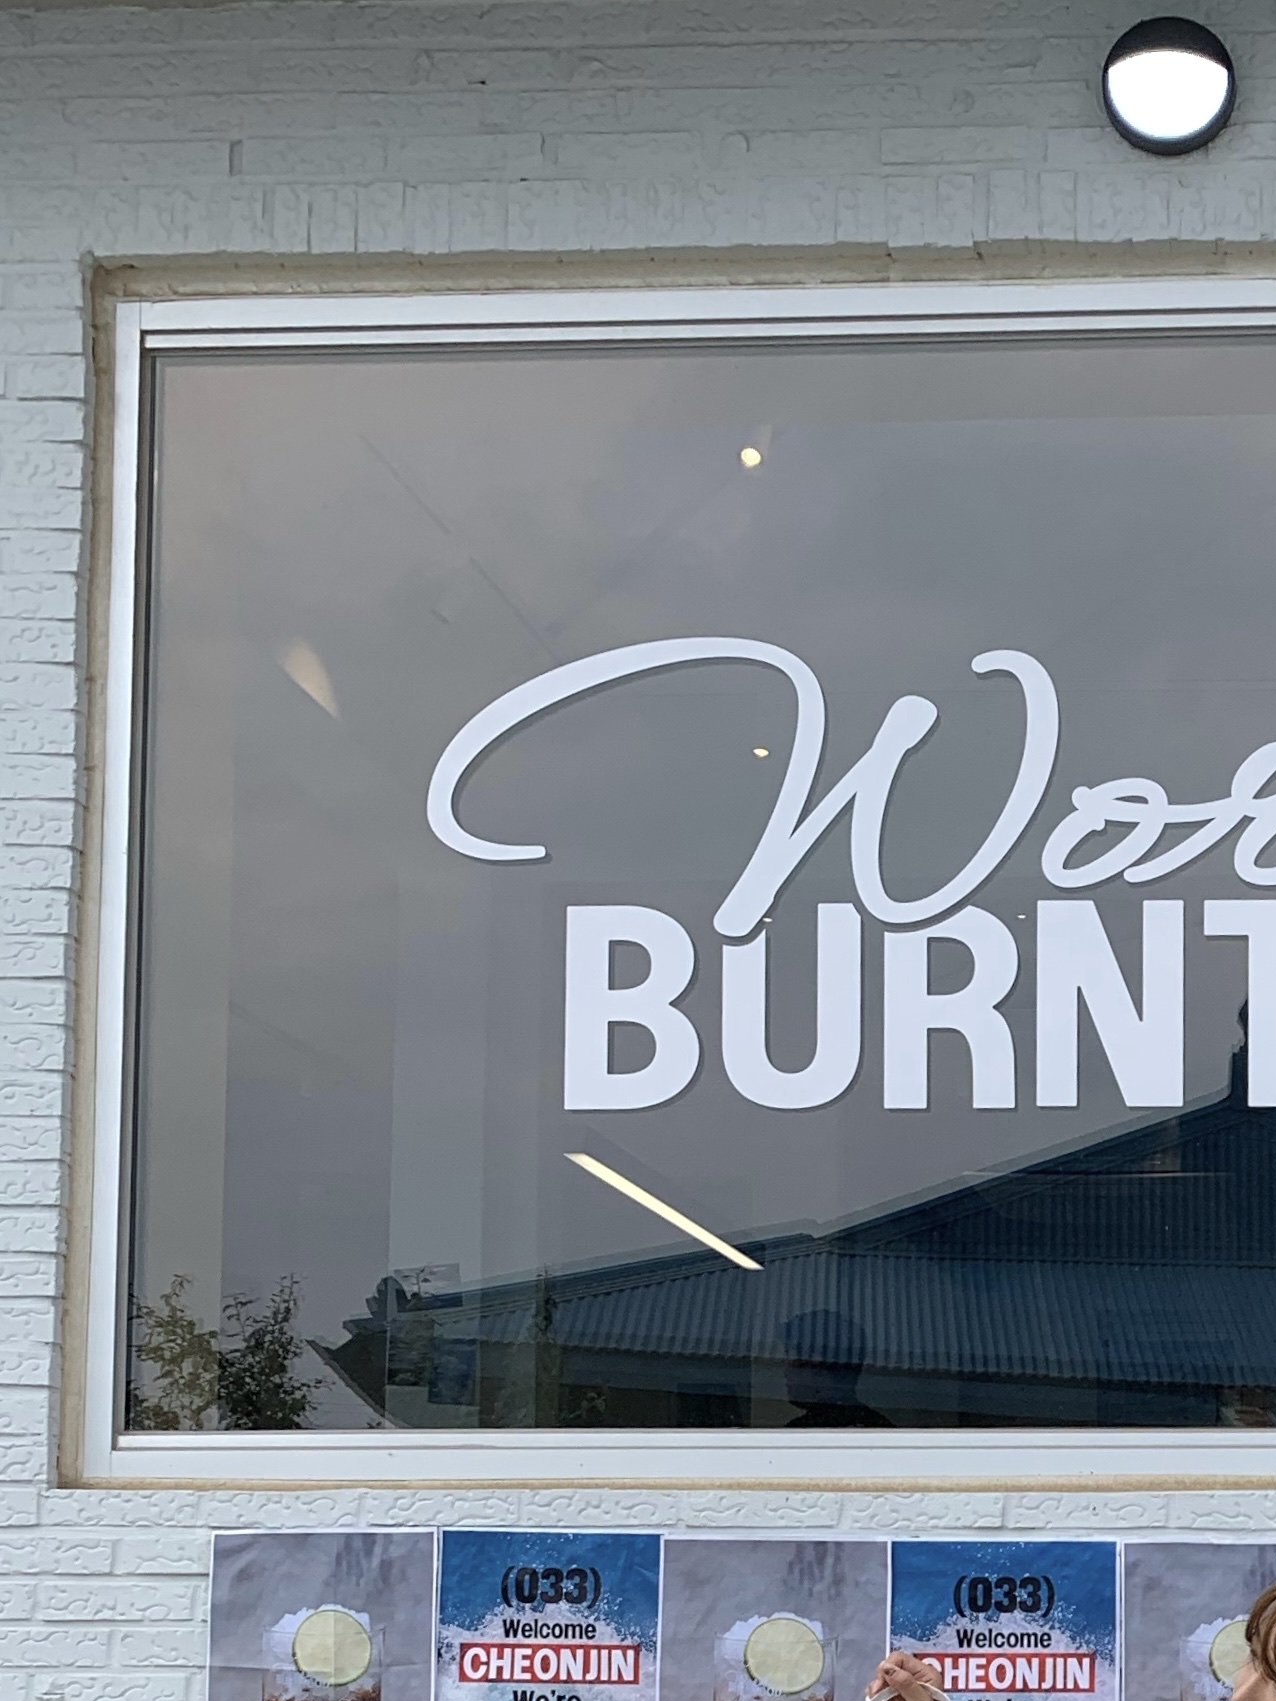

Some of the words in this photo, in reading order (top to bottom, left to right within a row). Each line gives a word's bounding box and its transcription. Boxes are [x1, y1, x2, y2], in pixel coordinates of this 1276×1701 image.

[501, 1566, 602, 1605] (033)
[953, 1575, 1056, 1618] (033)
[502, 1618, 597, 1641] Welcome
[956, 1628, 1053, 1649] Welcome
[463, 1647, 635, 1681] CHEONJIN
